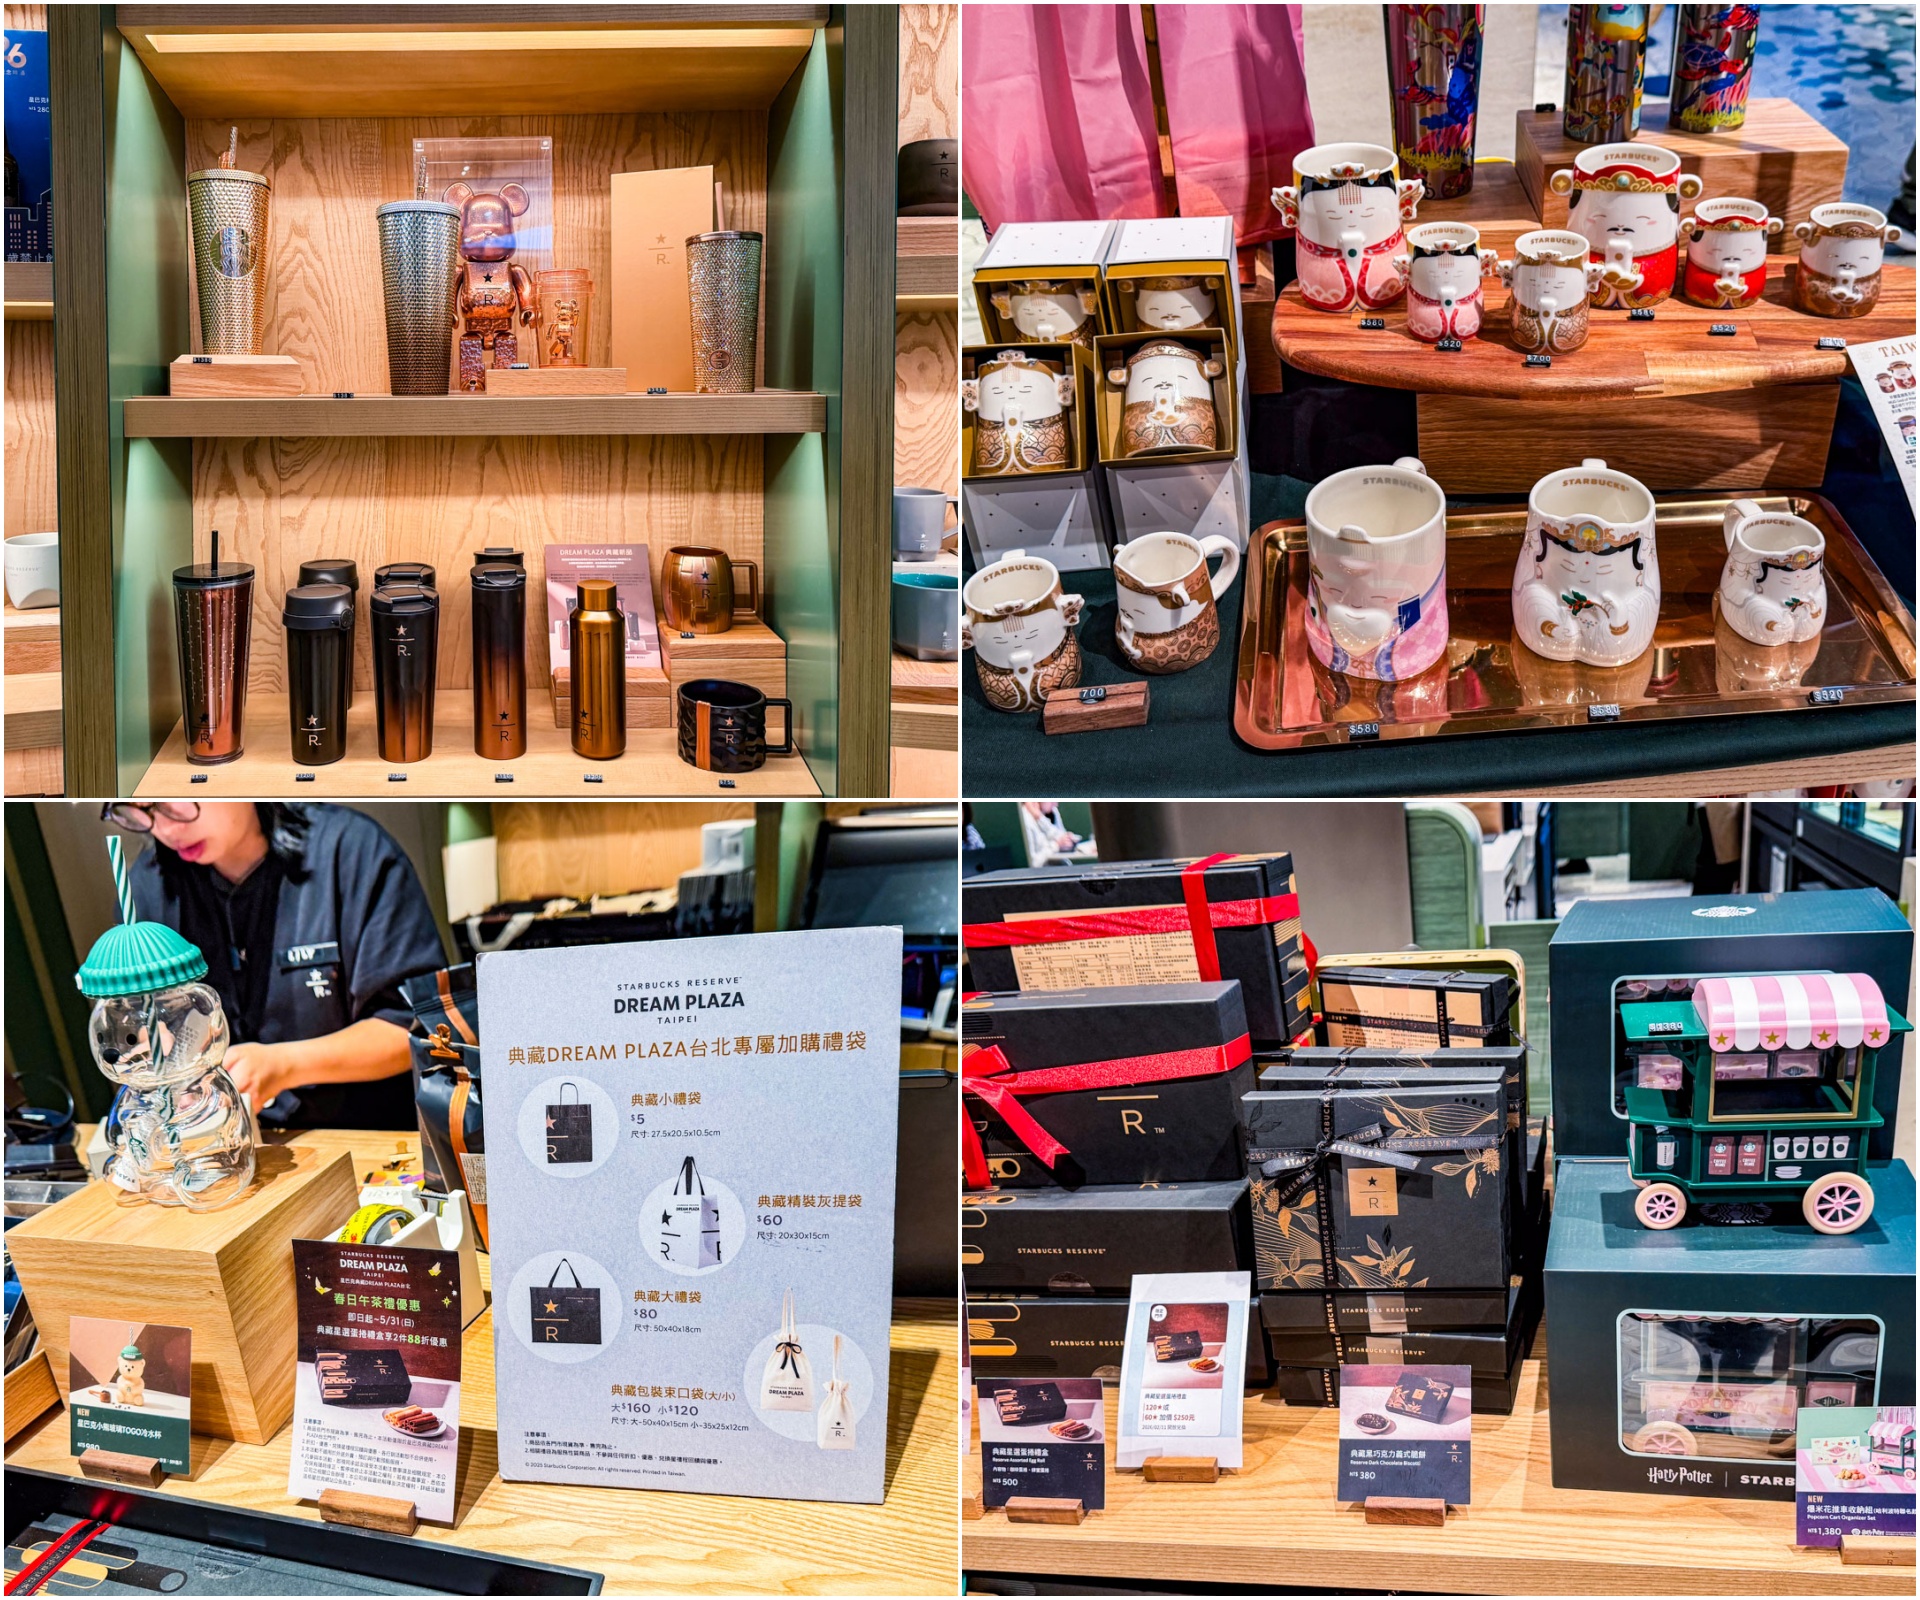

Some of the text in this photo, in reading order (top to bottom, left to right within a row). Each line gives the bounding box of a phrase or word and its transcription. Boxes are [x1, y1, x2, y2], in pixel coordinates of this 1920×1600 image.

[1604, 154, 1660, 163] STARBUCKS
[1419, 228, 1466, 238] STARBUCKS
[1530, 237, 1578, 246] STARBUCKS
[1562, 478, 1630, 492] STARBUCKS
[983, 563, 1043, 583] STARBUCKS
[1082, 688, 1104, 697] 700
[1349, 723, 1379, 734] $580
[617, 980, 680, 991] STARBUCKS
[614, 991, 745, 1014] DREAM PLAZA
[657, 1015, 697, 1025] TAIPEI
[508, 1030, 867, 1066] 典藏DREAM PLAZA台北專屬加購禮袋
[631, 1091, 702, 1107] 典藏小禮袋
[630, 1113, 645, 1125] $5
[1120, 1109, 1146, 1135] R
[630, 1129, 721, 1139] 尺寸: 27.5x20.5x10.5cm
[757, 1193, 863, 1208] 典藏精裝灰提袋
[1369, 1197, 1379, 1209] R
[757, 1214, 783, 1226] $60
[778, 1231, 830, 1240] 20x30x15cm
[340, 1251, 374, 1259] STARBUCKS
[1323, 1229, 1334, 1280] STARBUCKS
[339, 1258, 409, 1273] DREAM PLAZA
[333, 1292, 422, 1312] 春日午茶禮優惠
[634, 1289, 702, 1304] 典藏大禮袋
[634, 1308, 658, 1319] $80
[545, 1326, 559, 1342] R
[633, 1323, 702, 1333] 尺寸: 50x40x18cm
[611, 1384, 736, 1402] 典藏包裝束口袋(大/小)
[77, 1408, 90, 1417] NEW
[1359, 1472, 1376, 1480] 380
[1647, 1467, 1678, 1484] Harry
[1679, 1466, 1713, 1485] Potter
[1807, 1495, 1824, 1503] NEW
[1817, 1527, 1842, 1536] 1,380
